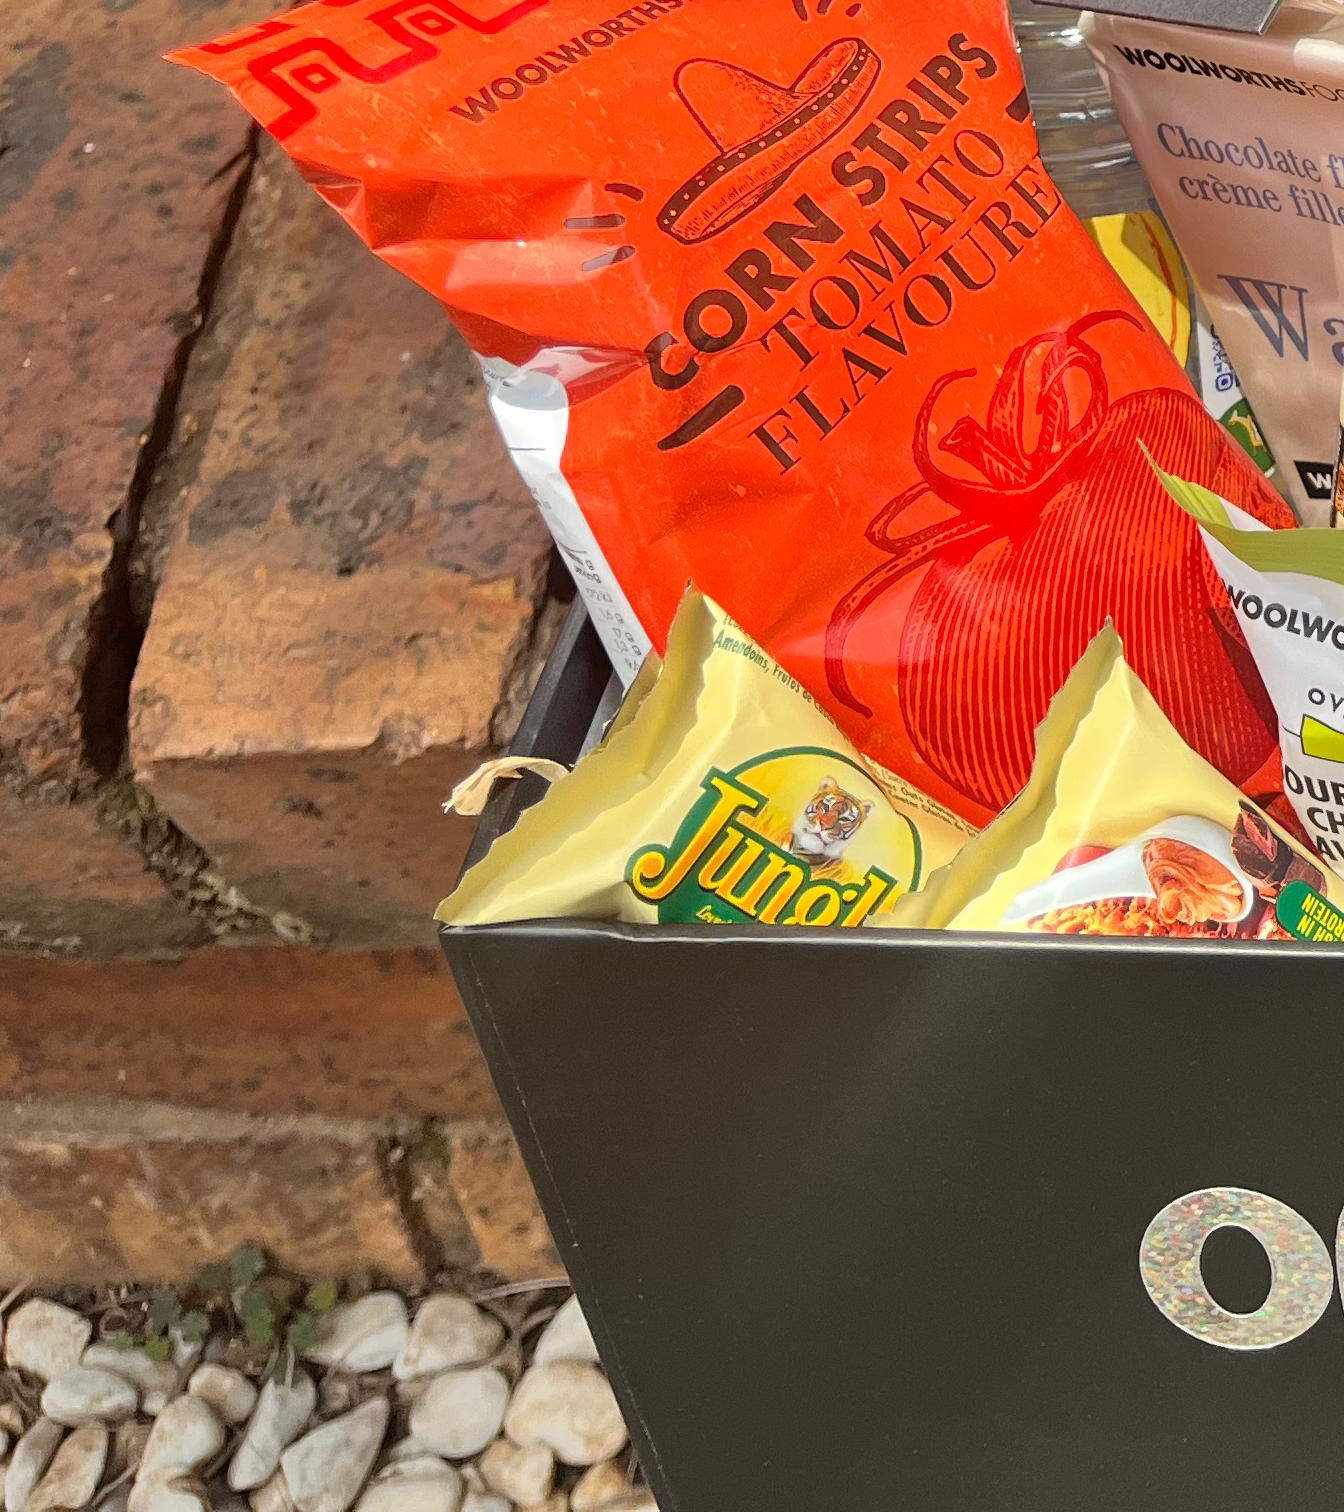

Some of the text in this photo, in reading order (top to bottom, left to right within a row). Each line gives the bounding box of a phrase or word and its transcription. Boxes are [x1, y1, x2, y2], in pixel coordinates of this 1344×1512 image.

[1156, 122, 1322, 184] Chocolate
[648, 30, 999, 391] CORN STRIPS
[1179, 173, 1282, 215] crème
[760, 128, 1004, 373] TOMATO
[1296, 914, 1316, 937] IN
